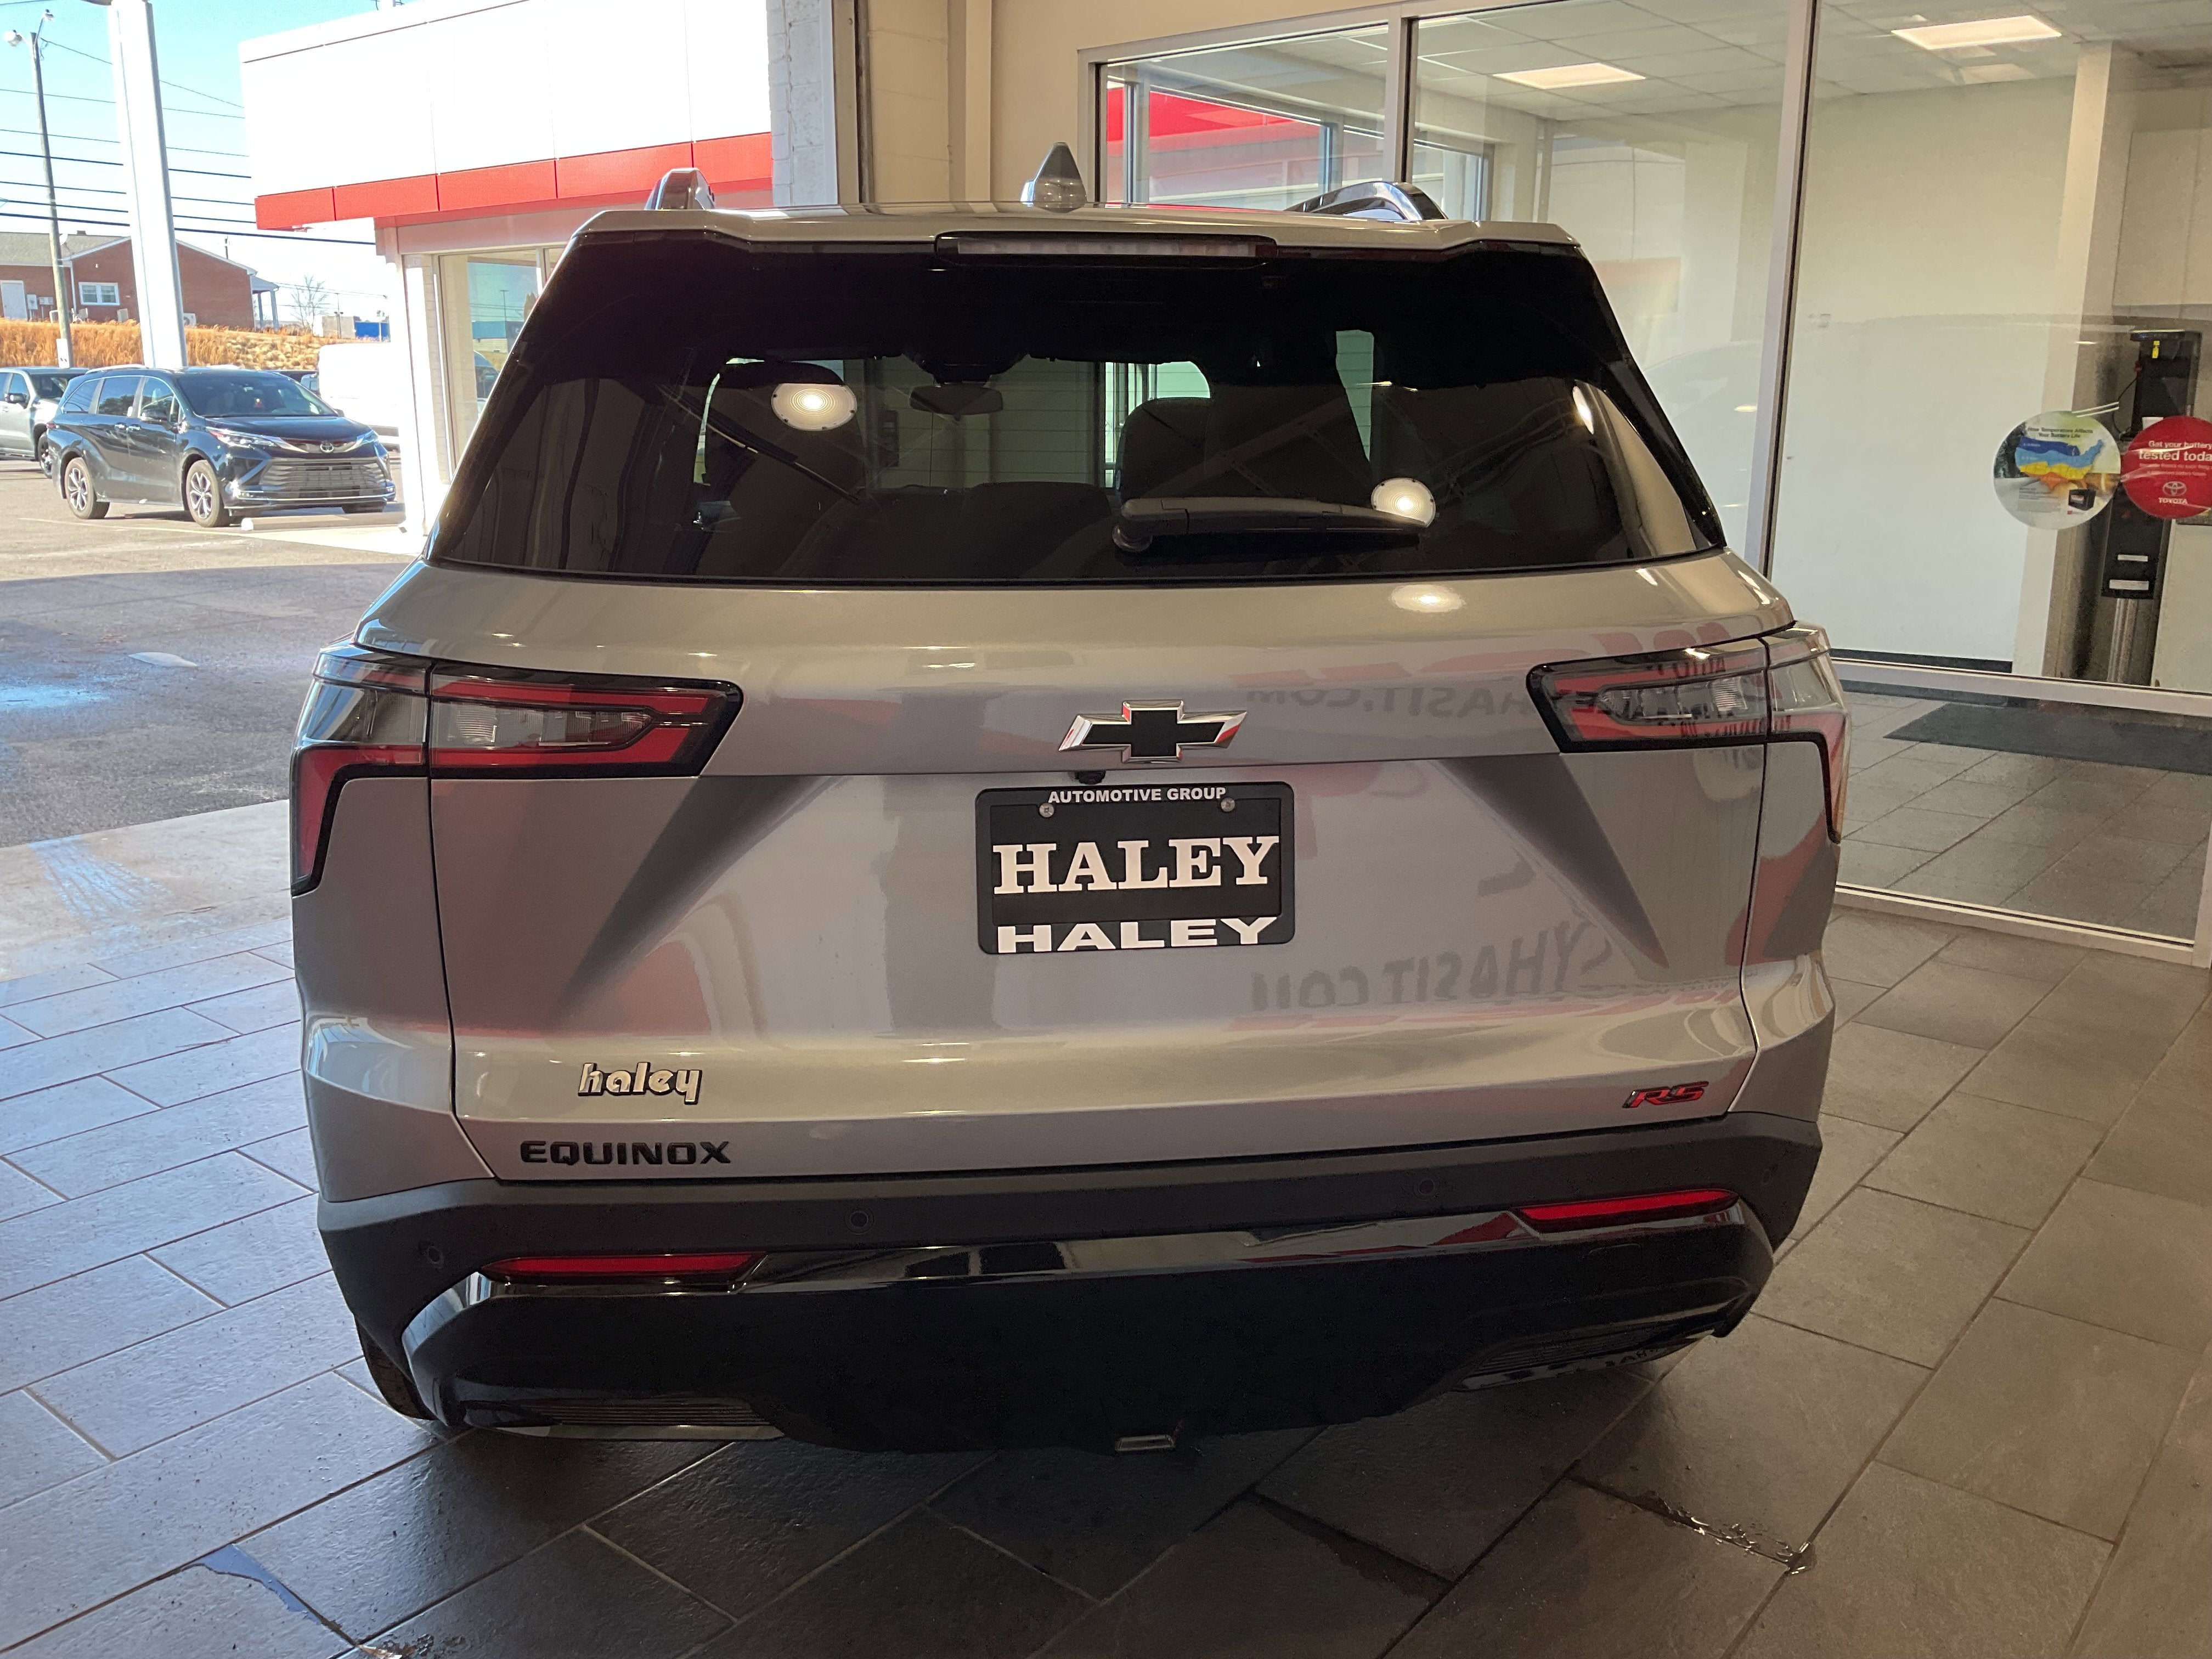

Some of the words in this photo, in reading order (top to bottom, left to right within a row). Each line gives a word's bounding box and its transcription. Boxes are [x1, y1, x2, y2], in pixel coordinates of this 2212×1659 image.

[2138, 449, 2180, 461] tested
[2183, 441, 2212, 450] battery
[1048, 788, 1161, 804] AUTOMOTIVE
[1166, 787, 1226, 801] GROUP
[992, 835, 1280, 895] HALEY
[997, 916, 1278, 954] HALEY
[577, 1061, 703, 1105] haley
[1622, 1081, 1709, 1109] RS
[520, 1140, 731, 1166] EQUINOX
